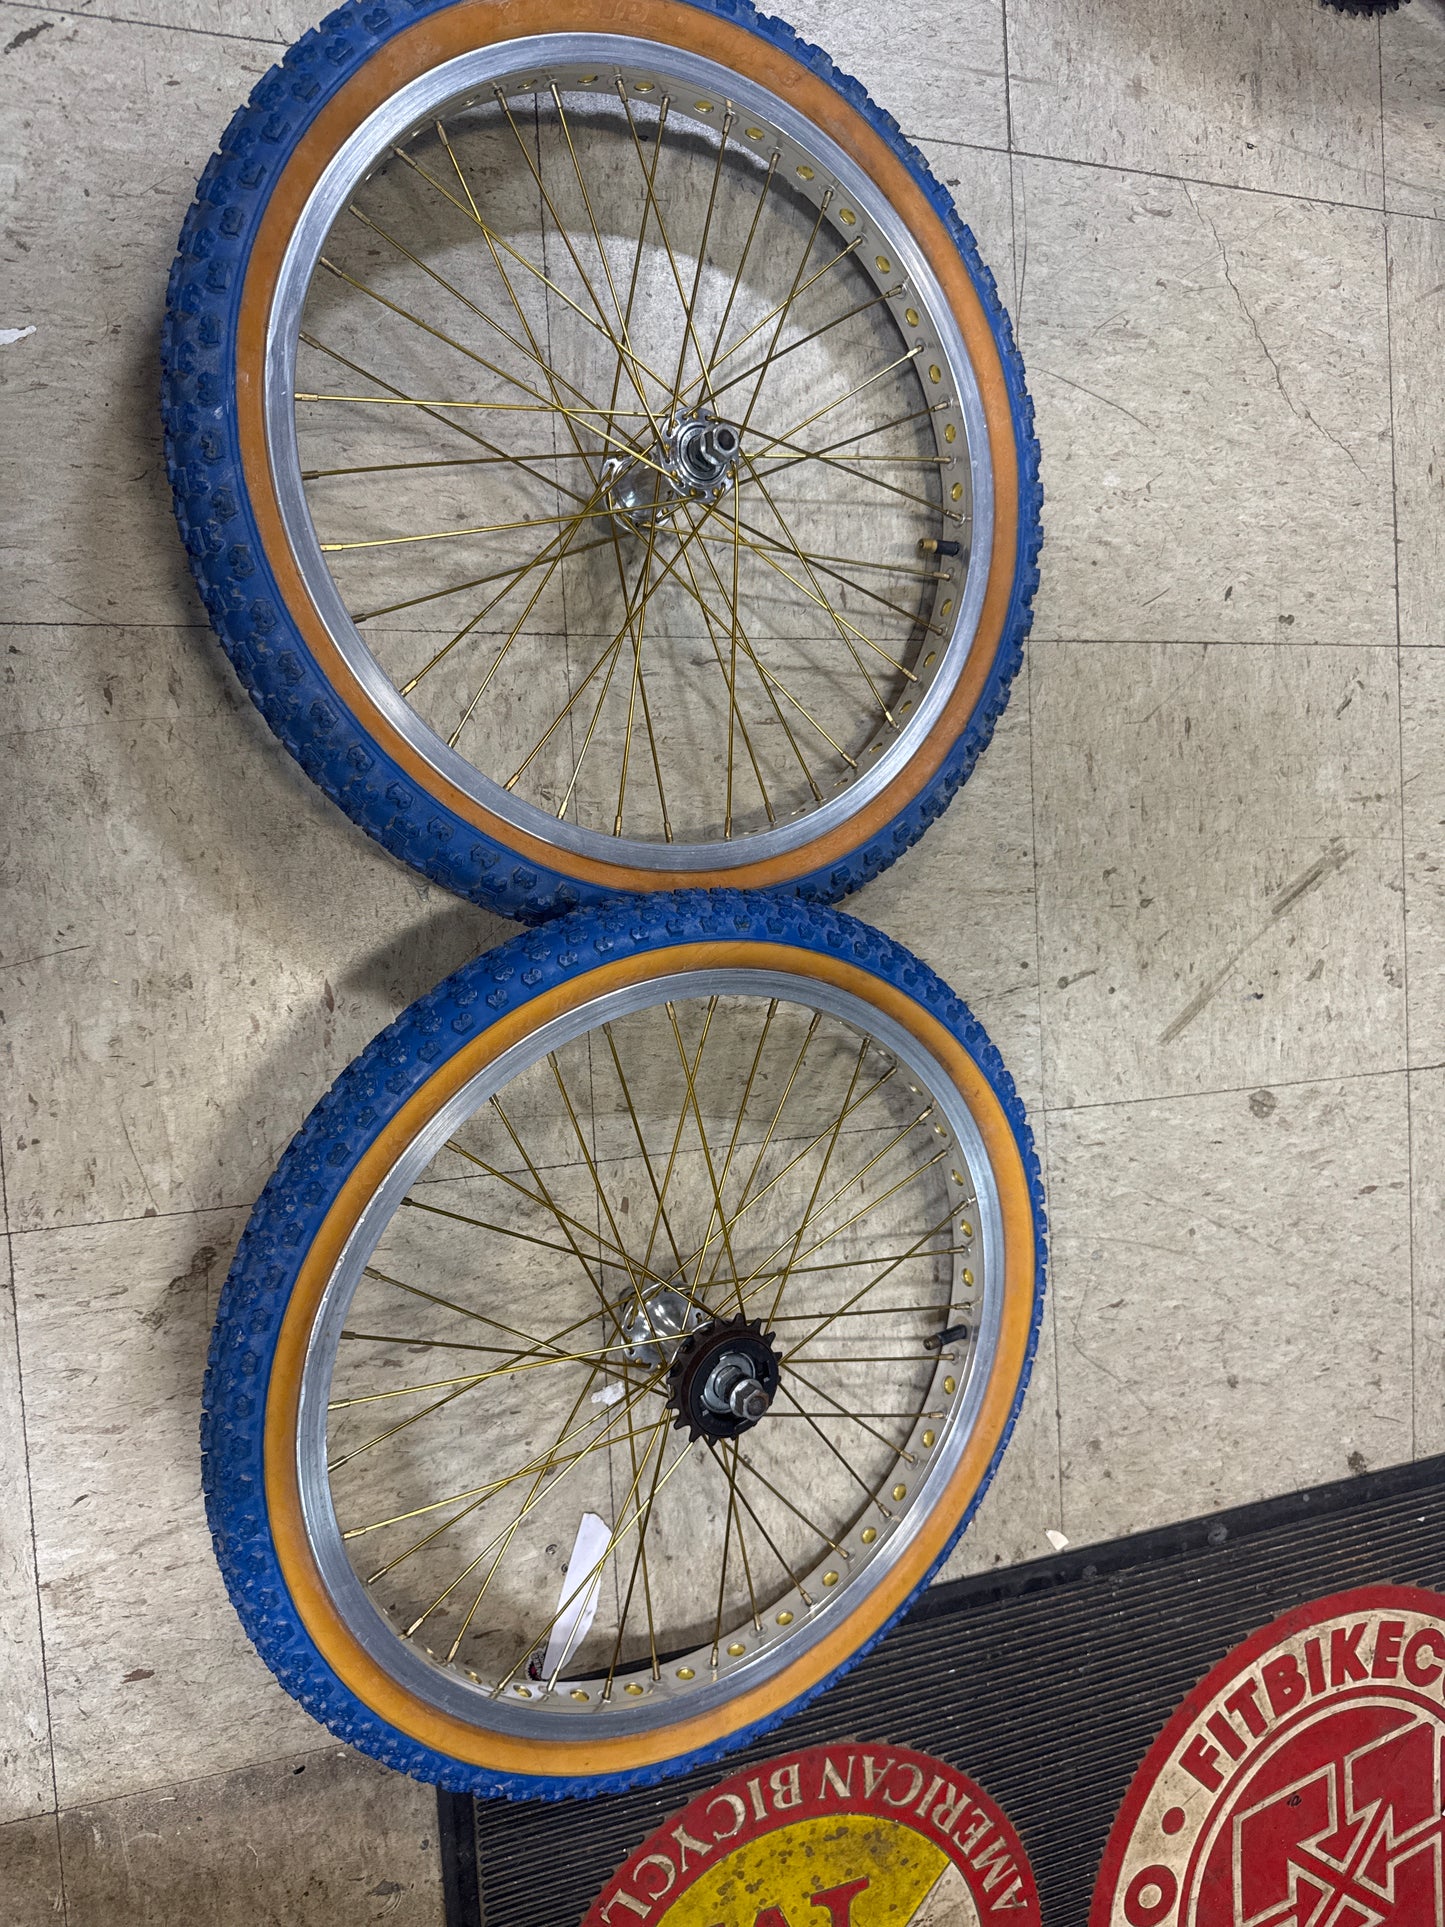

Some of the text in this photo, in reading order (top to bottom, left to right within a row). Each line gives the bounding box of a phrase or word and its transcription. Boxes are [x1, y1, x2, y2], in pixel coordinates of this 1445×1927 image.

[1178, 1620, 1445, 1794] FITBIKEC
[600, 1755, 1028, 1924] AMERICAN BICYCL
